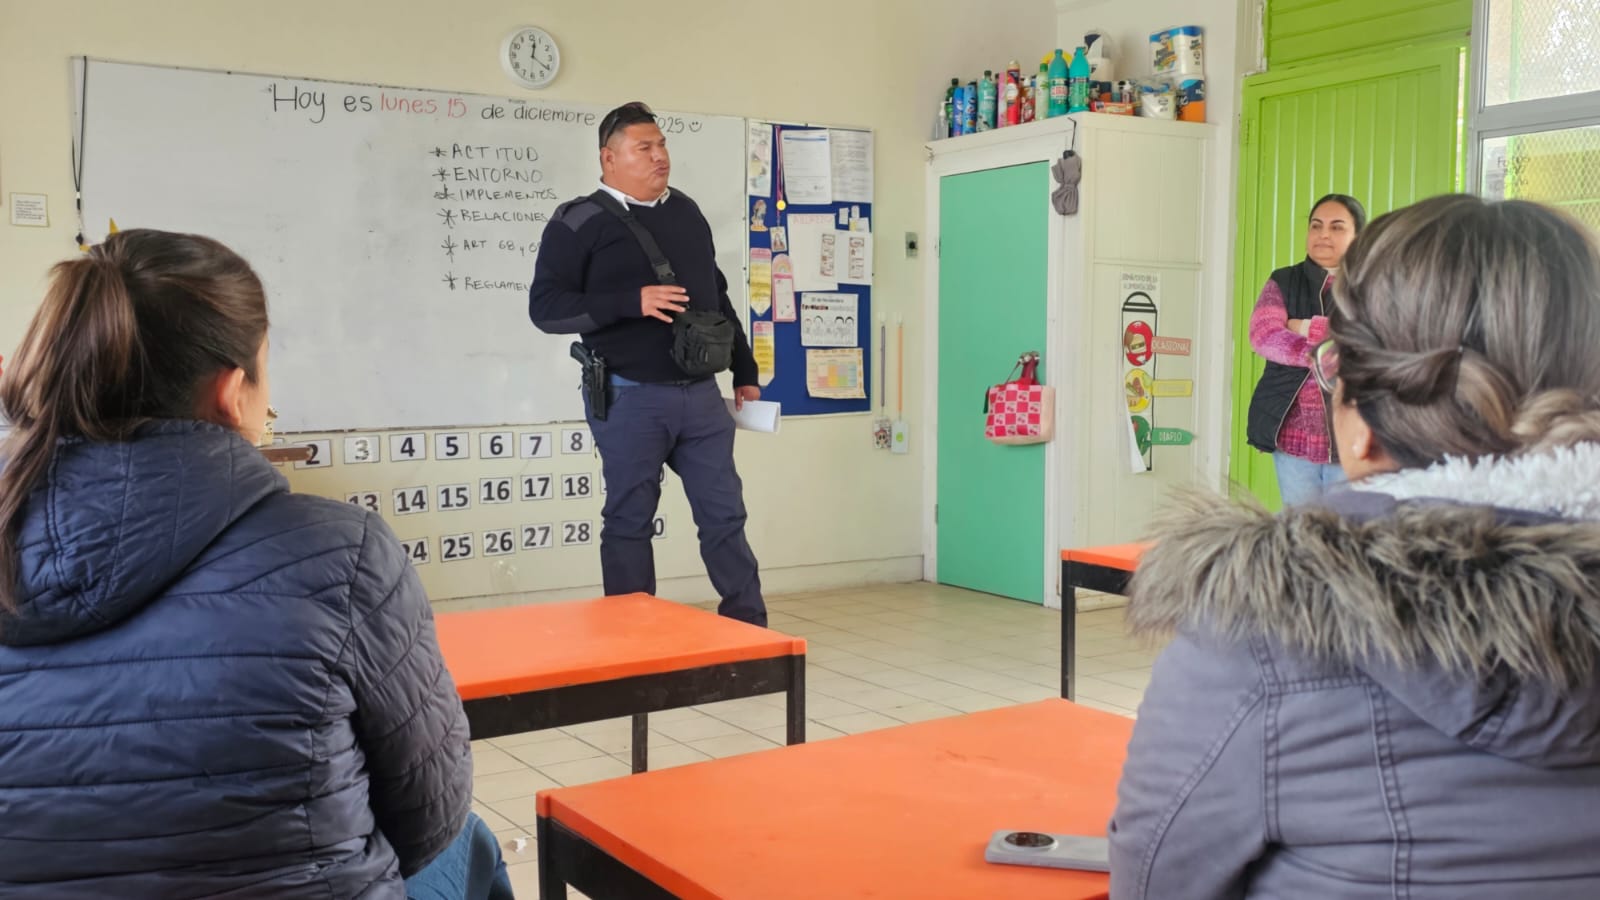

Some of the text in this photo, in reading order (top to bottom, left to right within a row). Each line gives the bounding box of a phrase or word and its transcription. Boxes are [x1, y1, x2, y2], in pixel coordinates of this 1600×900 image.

[273, 83, 685, 134] Hoy es lunes 15 de diciembre 025
[452, 143, 538, 162] ACTITUD
[453, 167, 544, 183] ENTORNO
[459, 187, 559, 201] IMPLEMENTOS
[460, 209, 549, 223] RELACIONES
[463, 239, 487, 250] ART
[499, 240, 516, 251] 68
[528, 241, 542, 253] 6
[305, 432, 583, 465] 2 3 4 5 6 7 8
[397, 489, 426, 513] 14
[440, 487, 468, 509] 15
[483, 480, 510, 501] 16
[523, 477, 550, 498] 17
[564, 476, 590, 497] 18
[443, 536, 472, 559] 25
[485, 531, 513, 554] 26
[523, 526, 551, 548] 27
[564, 522, 590, 544] 28
